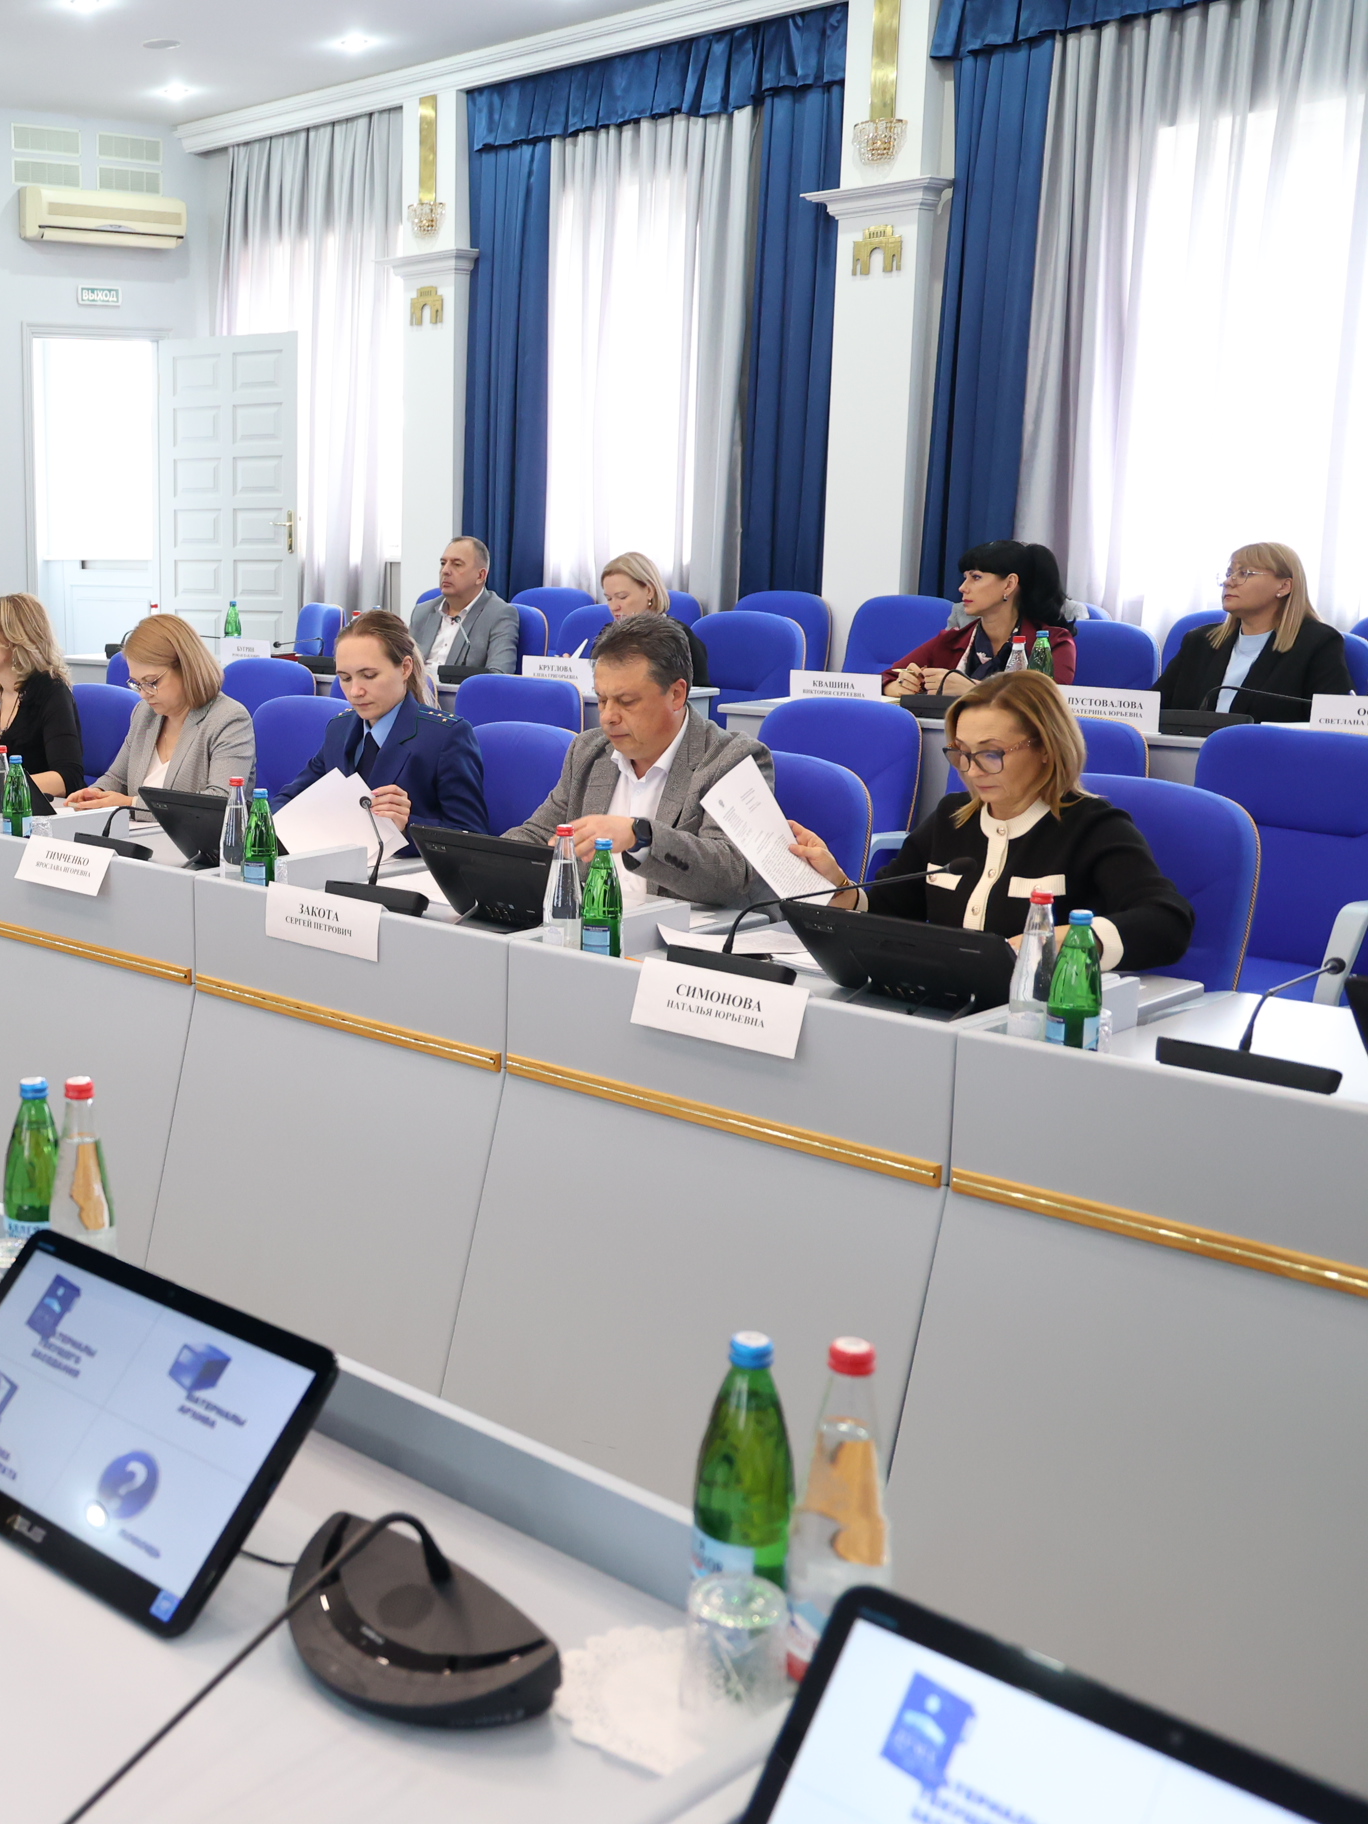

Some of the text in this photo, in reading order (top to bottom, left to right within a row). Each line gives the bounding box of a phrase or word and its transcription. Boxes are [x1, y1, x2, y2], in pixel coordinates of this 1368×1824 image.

[82, 289, 118, 302] ВЫХОД
[538, 664, 573, 673] КРУГЛОВА
[812, 680, 855, 690] КВАШИНА
[1067, 696, 1144, 710] ПУСТОВАЛОВА
[1108, 710, 1143, 719] ЮРЬЕВНА
[1318, 717, 1365, 726] СВЕТЛАНА
[45, 850, 90, 867] ТИМЧЕНКО
[35, 861, 91, 878] ЯРОСЛАВА ИГОРЕВНА
[298, 903, 340, 922] ЗАКОТА
[285, 915, 353, 938] СЕРГЕЙ ПЕТРОВИЧ
[675, 983, 762, 1013] СИМОНОВА
[666, 999, 765, 1029] НАТАЛЬЯ ЮРЬЕВНА
